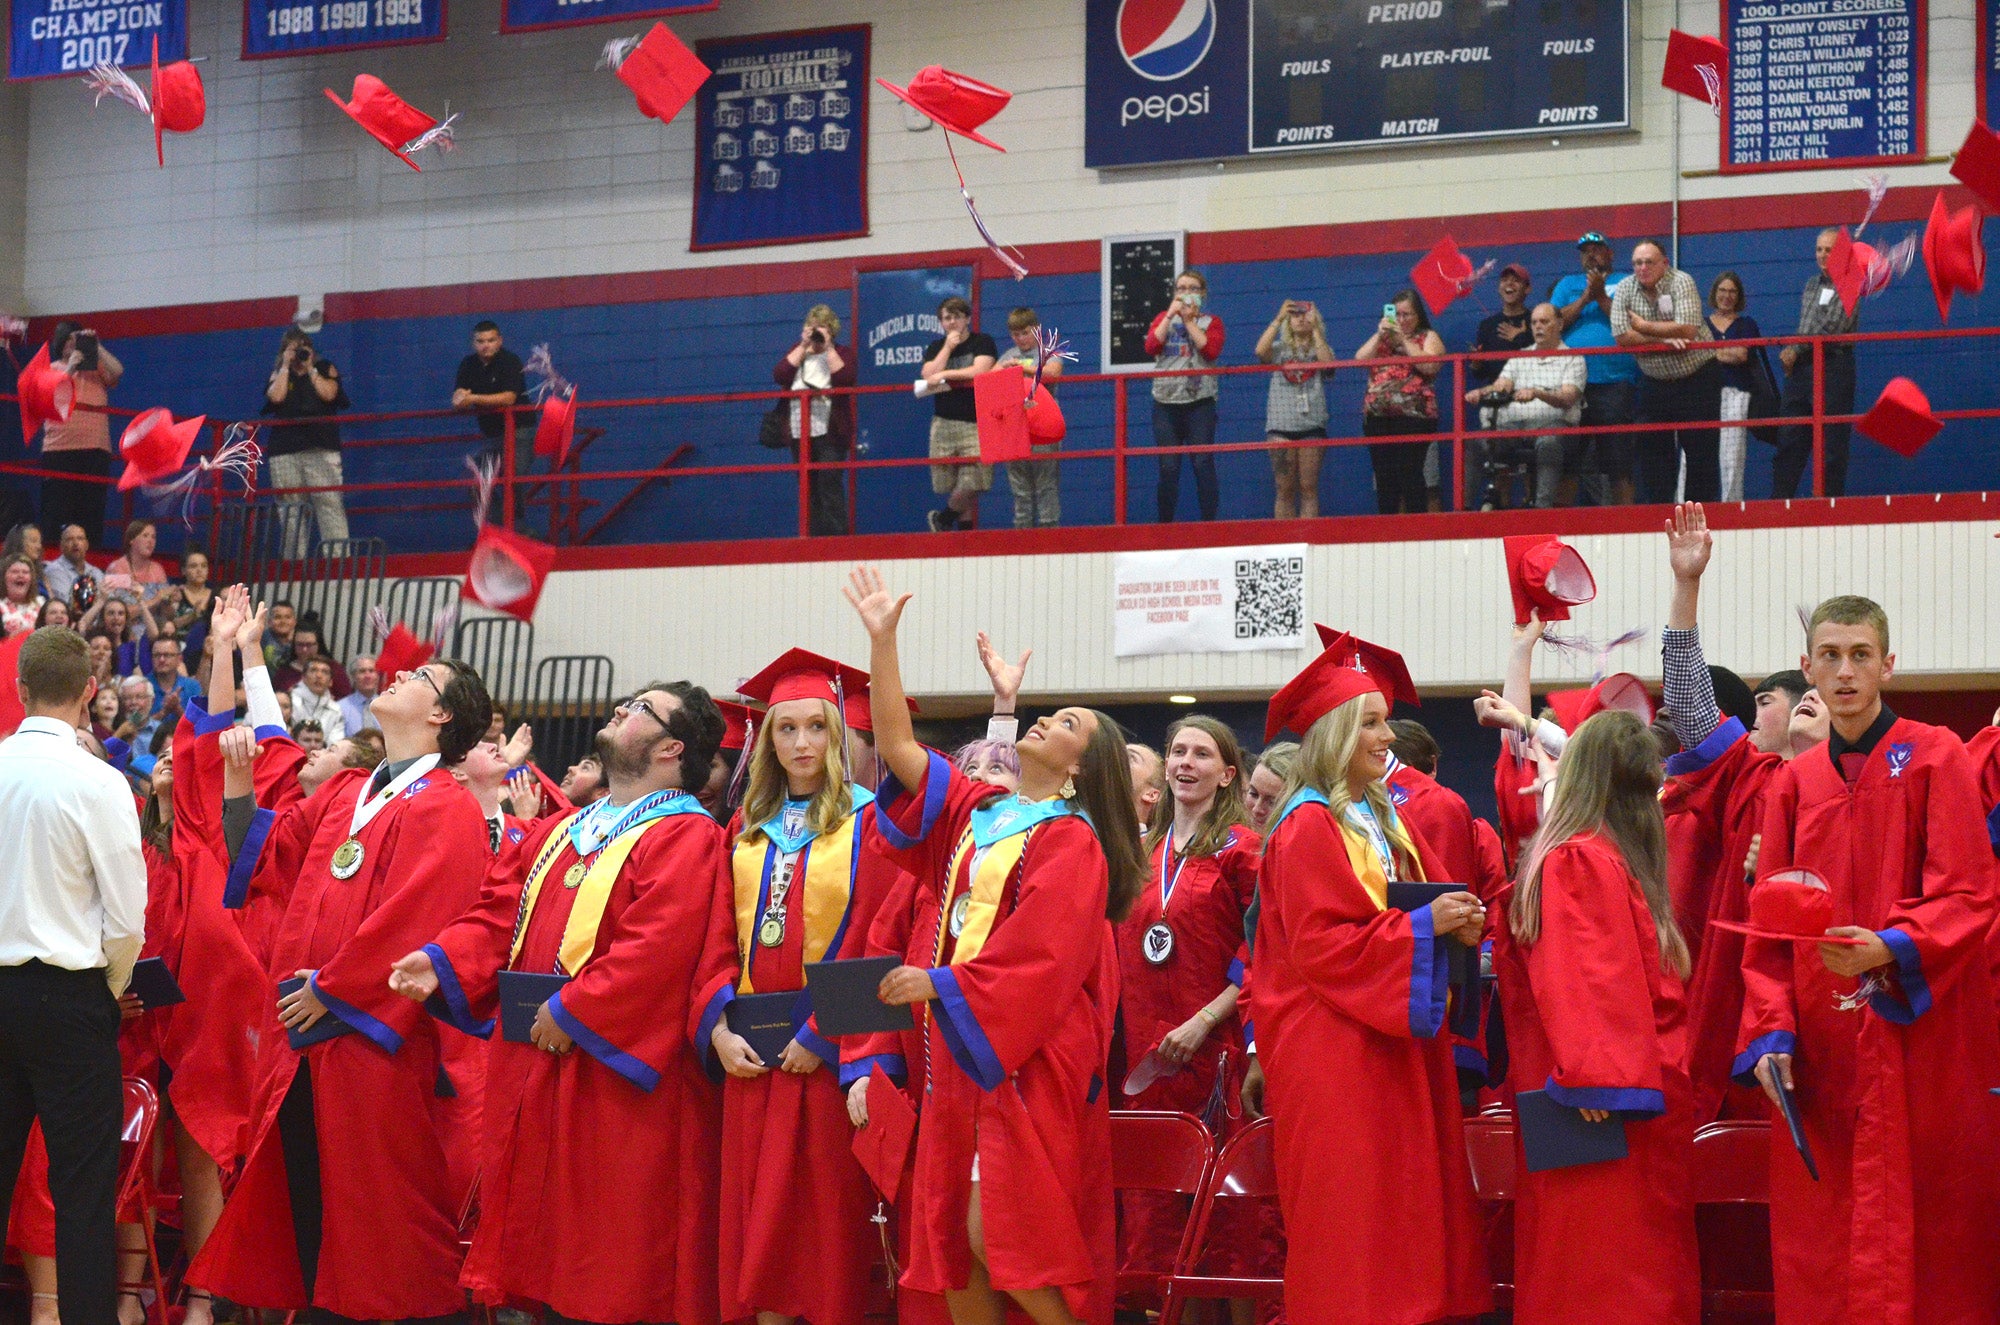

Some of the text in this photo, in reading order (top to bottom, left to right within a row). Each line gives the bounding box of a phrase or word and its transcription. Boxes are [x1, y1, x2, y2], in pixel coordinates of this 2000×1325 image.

[267, 0, 422, 37] 1988 1990 1993
[1367, 0, 1443, 24] PERIOD
[1741, 0, 1906, 18] 1000 POINT SCORERS
[31, 3, 163, 40] CHAMPION
[1735, 15, 1909, 38] 1980 TOMMY OWSLEY 1,070
[61, 33, 130, 70] 2007
[1543, 38, 1596, 56] FOULS
[1735, 30, 1909, 52] 1990 CHRIS TURNEY 1,023
[1380, 46, 1492, 69] PLAYER-FOUL
[1735, 44, 1908, 65] 1997 HAGEN WILLIAMS 1,377
[741, 64, 821, 90] FOOTBALL
[1281, 59, 1332, 77] FOULS
[1734, 58, 1909, 79] 2001 KEITH WITHROW 1,485
[1734, 71, 1909, 93] 2008 NOAH KEETON 1,090
[820, 96, 850, 117] 1990
[1121, 85, 1210, 127] pepsi
[1734, 86, 1908, 108] 2008 DANIEL RALSTON 1,044
[1538, 104, 1599, 123] POINTS
[1734, 100, 1908, 121] 2008 RYAN YOUNG 1,482
[1277, 124, 1335, 143] POINTS
[1381, 118, 1440, 136] MATCH
[1734, 114, 1908, 135] 2009 ETHAN SPURLIN 1,145
[820, 129, 850, 150] 1997
[1734, 129, 1908, 149] 2011 ZACK HILL 1,180
[1734, 142, 1908, 163] 2013 LUKE HILL 1,219
[869, 314, 914, 348] LINCOLN
[875, 345, 928, 366] BASEB
[1119, 582, 1152, 595] GRADUATION
[1173, 580, 1186, 592] SEEN
[1200, 579, 1208, 591] ON
[1209, 578, 1220, 590] THE
[1161, 595, 1182, 608] SCHOOL
[1202, 594, 1223, 606] CENTER
[1147, 610, 1189, 623] FACEBOOK PAGE
